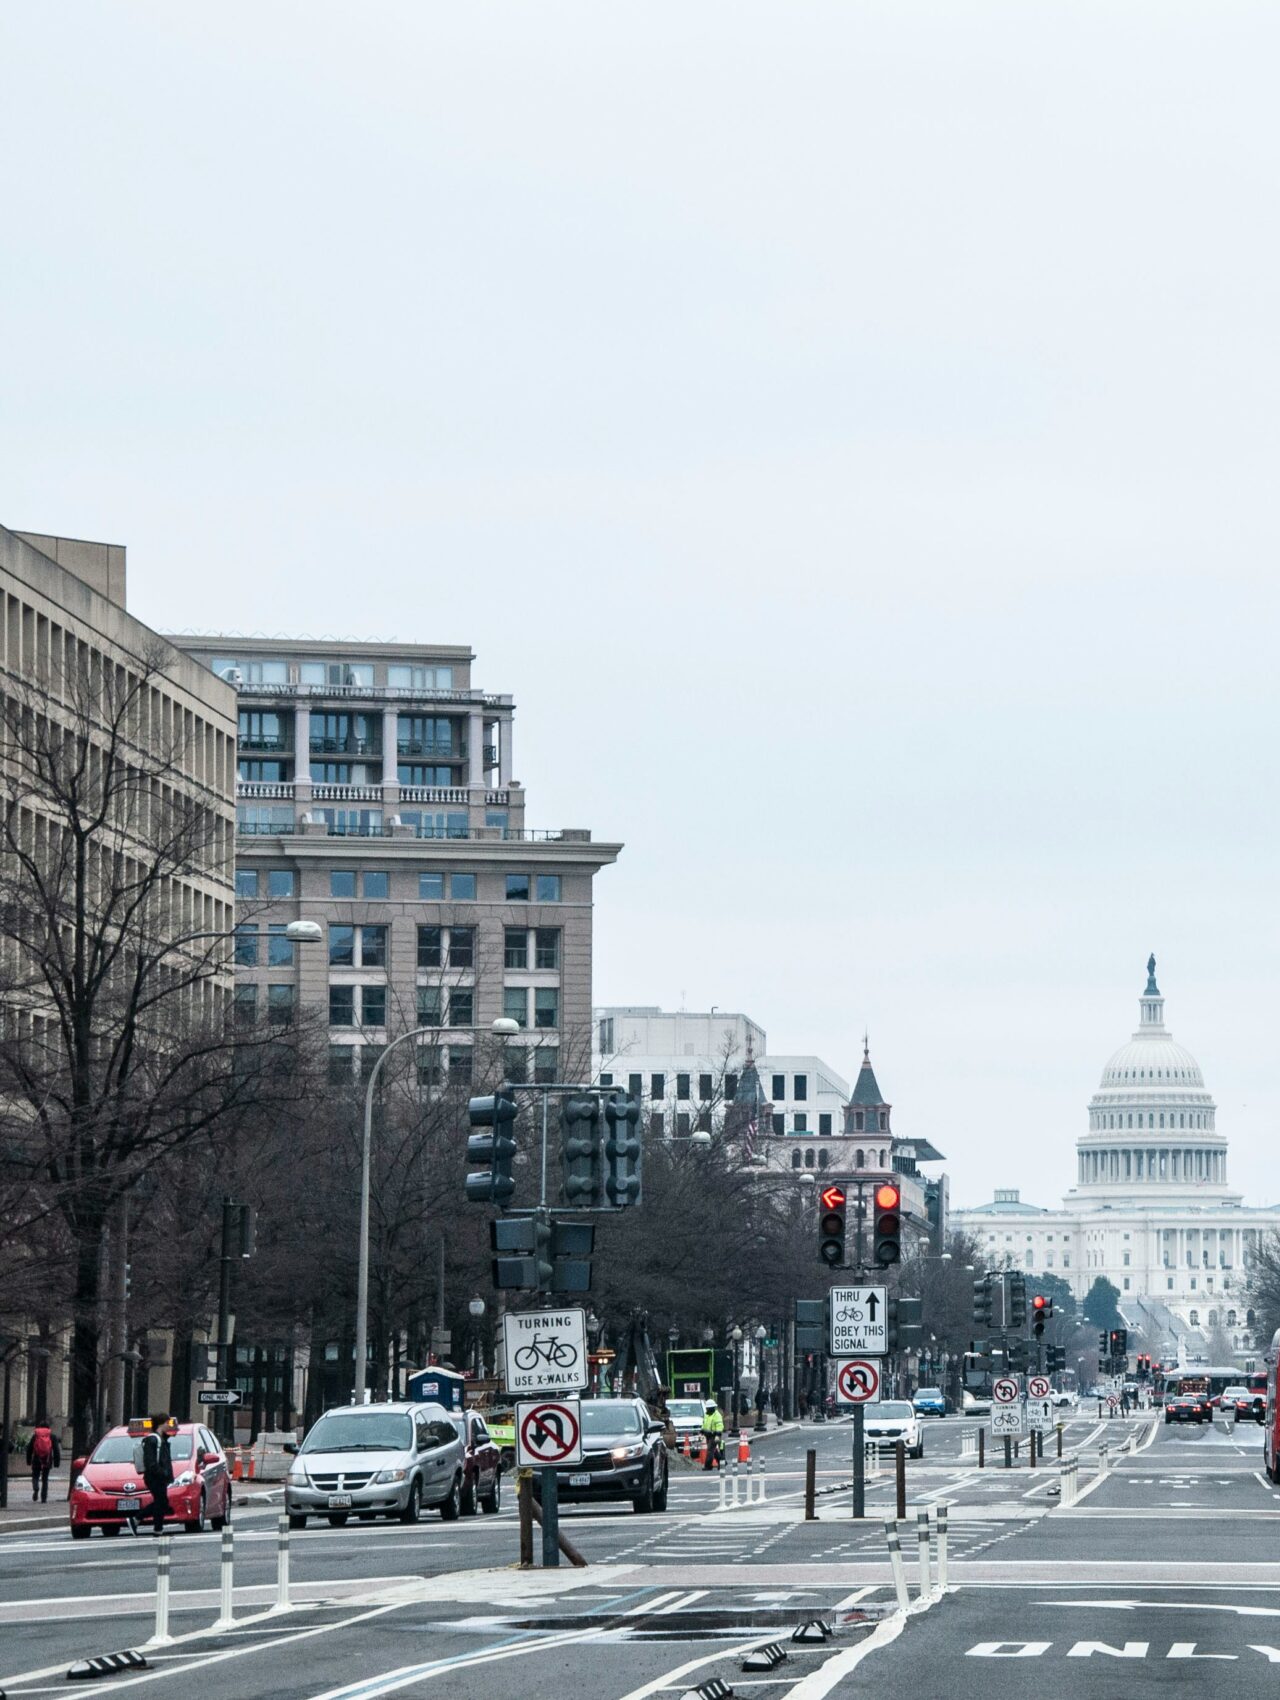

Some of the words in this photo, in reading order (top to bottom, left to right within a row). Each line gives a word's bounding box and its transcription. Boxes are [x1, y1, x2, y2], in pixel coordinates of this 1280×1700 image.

[835, 1291, 860, 1302] THRU
[518, 1316, 572, 1329] TURNING
[834, 1325, 860, 1337] OBEY
[863, 1325, 884, 1336] THIS
[834, 1338, 868, 1350] SIGNAL
[514, 1375, 533, 1387] USE
[537, 1372, 580, 1385] X-WALKS
